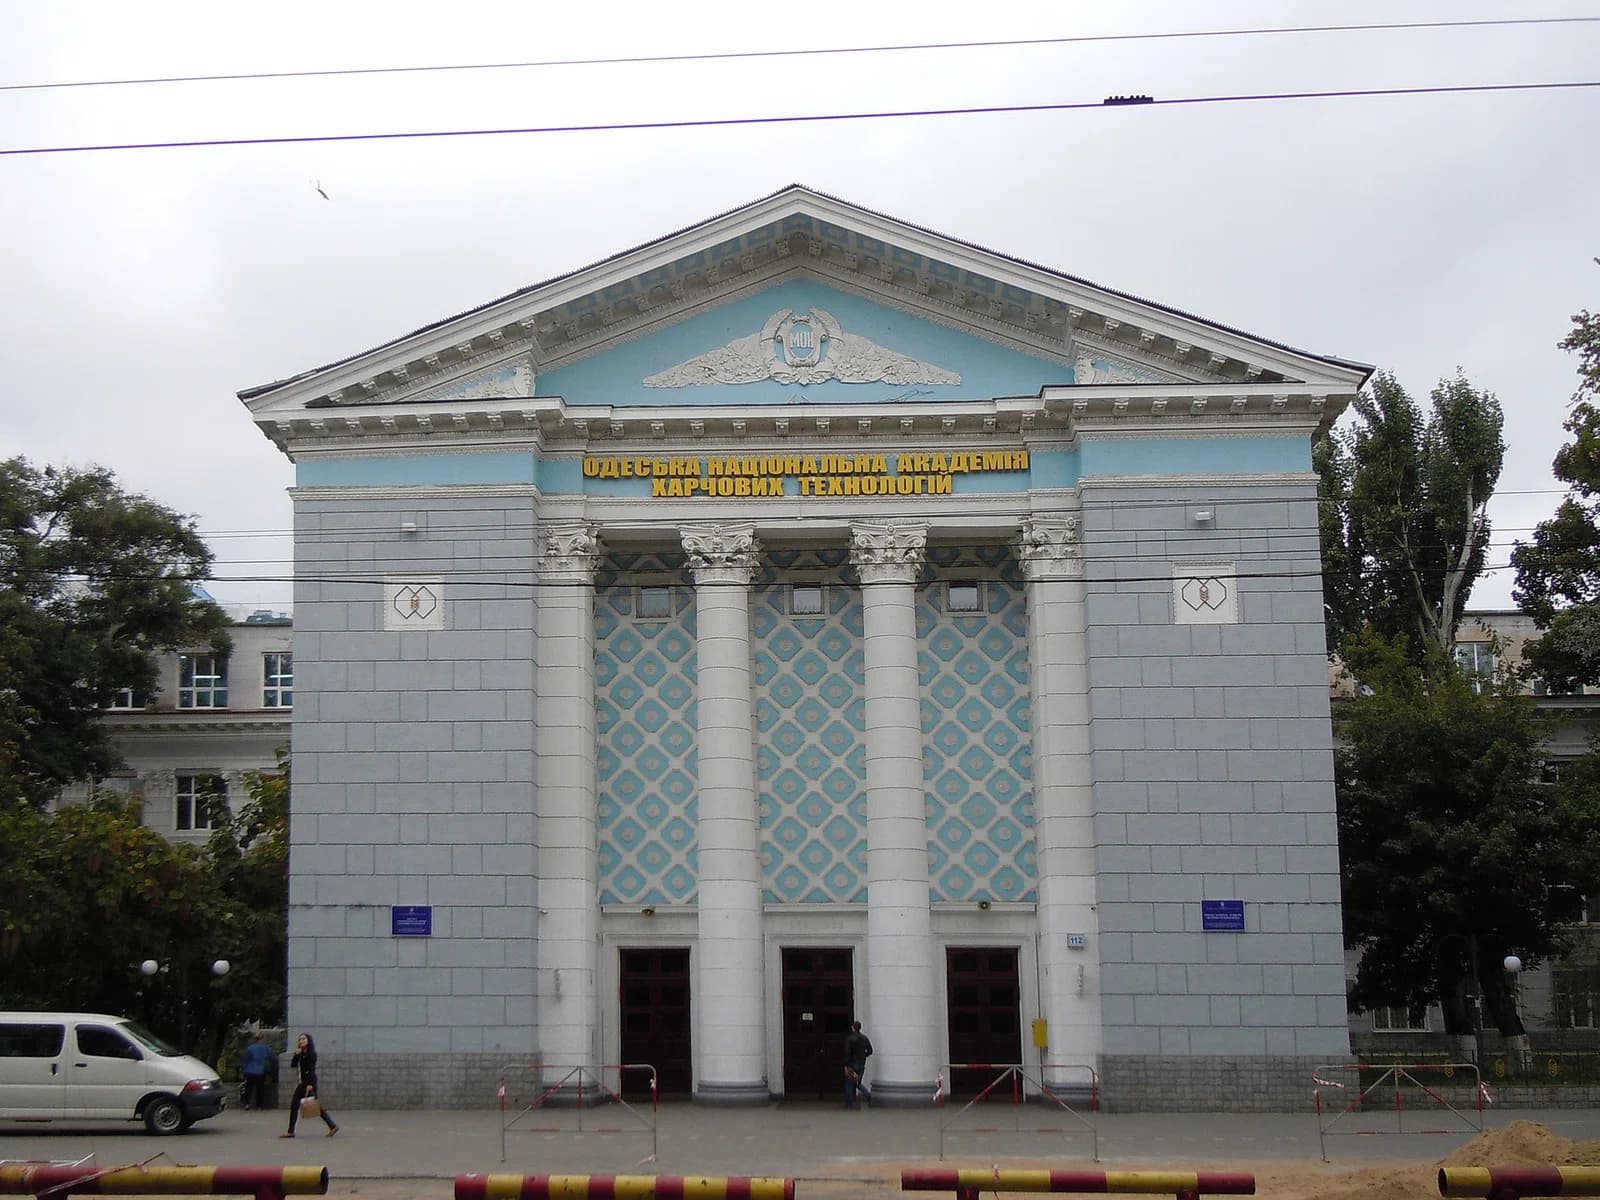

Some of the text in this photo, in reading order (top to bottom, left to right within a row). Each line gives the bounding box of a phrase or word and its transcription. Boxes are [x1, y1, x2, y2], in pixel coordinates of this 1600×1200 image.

[583, 451, 1029, 479] ОДЕСЬКА НАЦІОНАЛЬНА АКАДЕМІЯ
[652, 471, 951, 497] ХАРЧОВИХ ТЕХНОЛОГІЙ
[1070, 936, 1083, 944] 112
